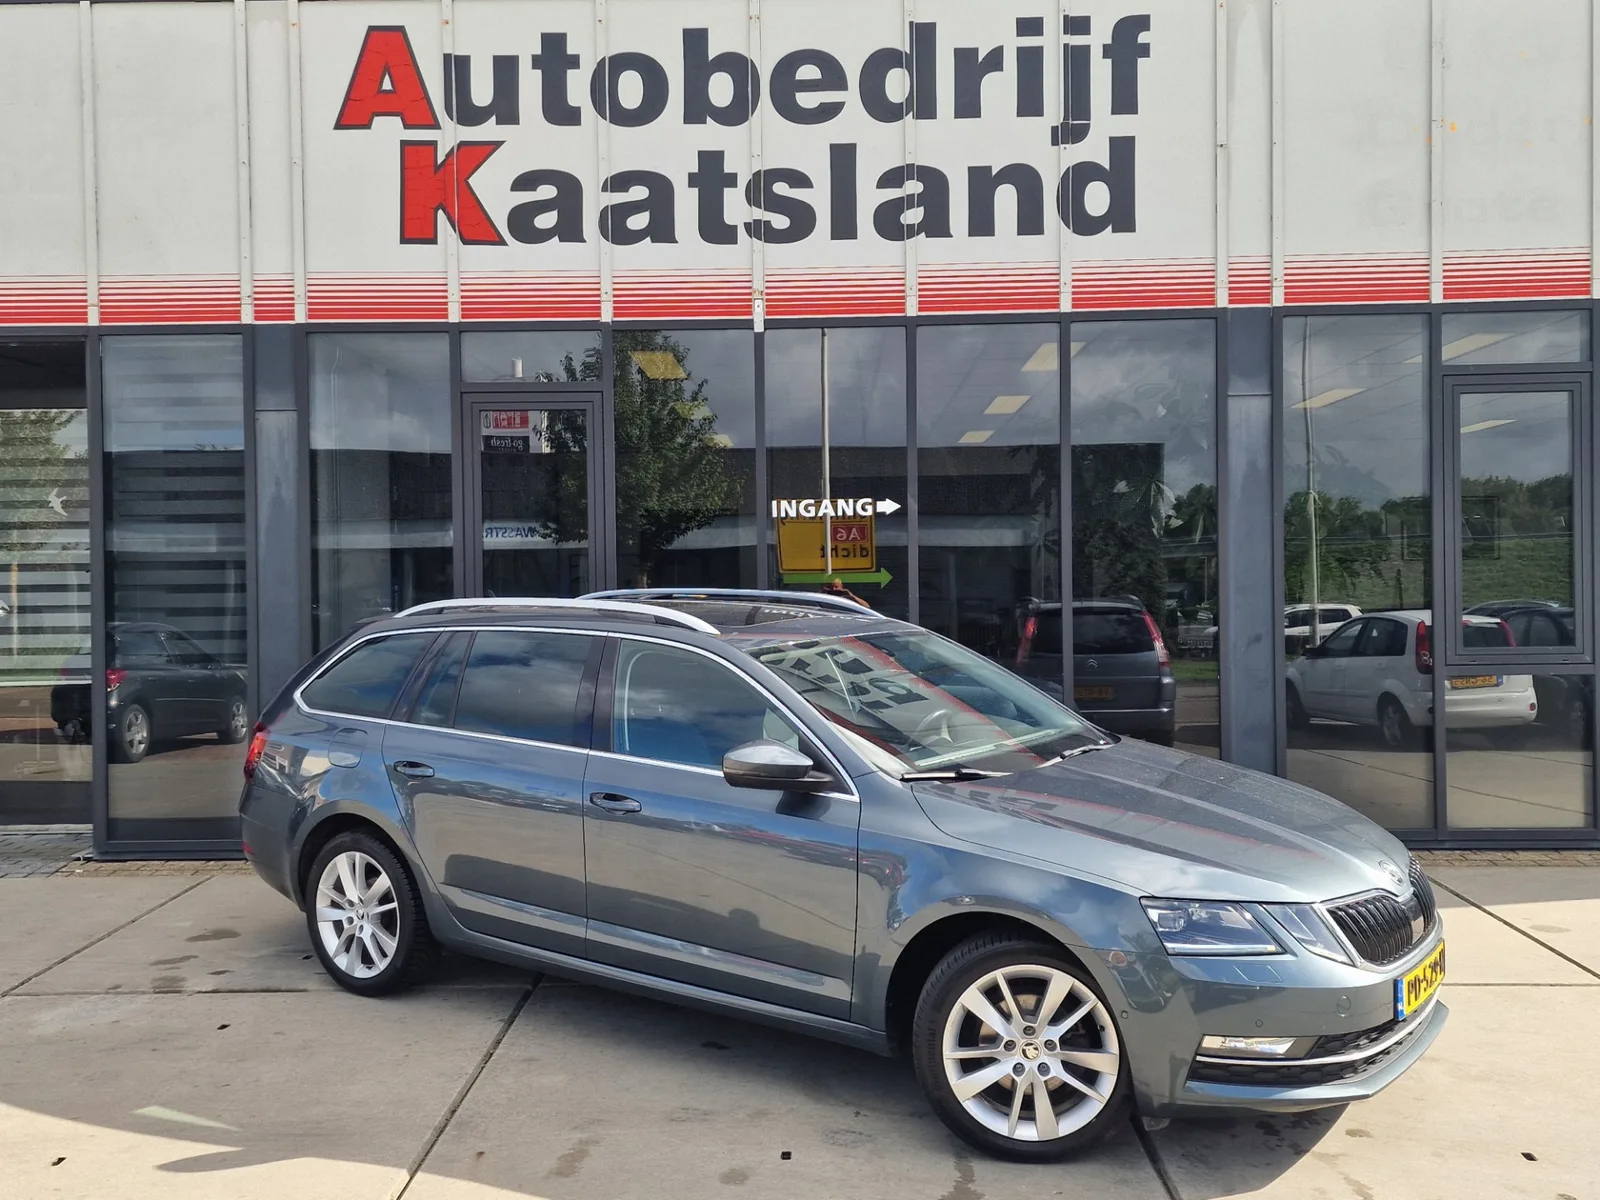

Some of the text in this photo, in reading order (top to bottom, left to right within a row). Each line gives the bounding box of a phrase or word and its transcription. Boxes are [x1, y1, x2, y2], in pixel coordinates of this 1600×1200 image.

[334, 14, 1151, 146] Autobedrijf
[399, 135, 1136, 245] Kaatsland
[771, 497, 873, 518] INGANG
